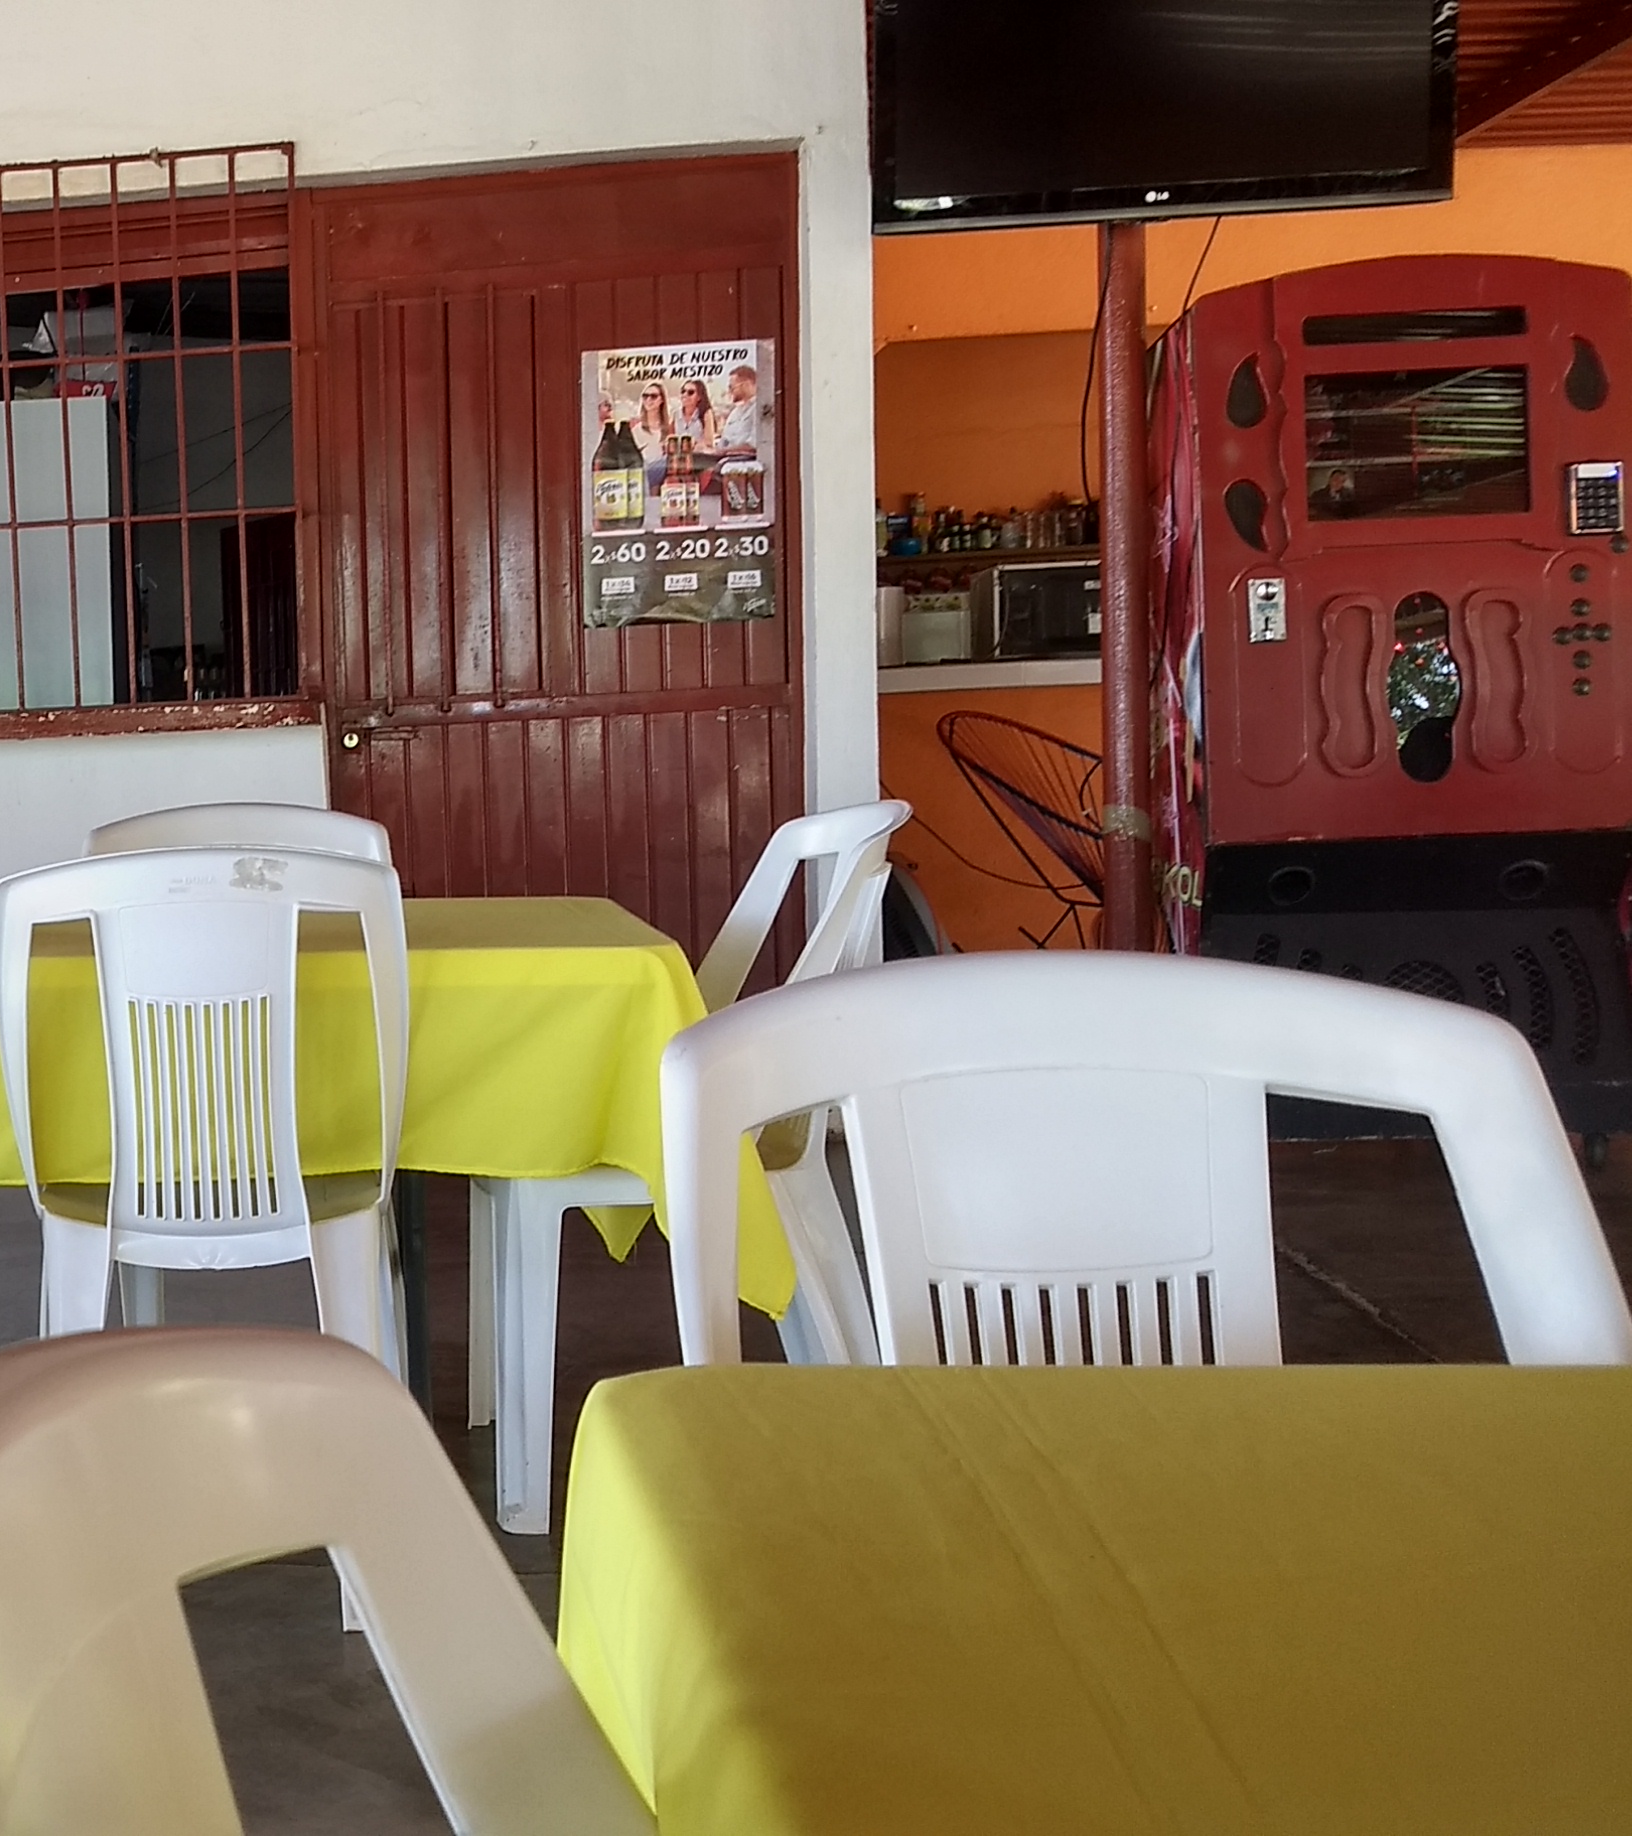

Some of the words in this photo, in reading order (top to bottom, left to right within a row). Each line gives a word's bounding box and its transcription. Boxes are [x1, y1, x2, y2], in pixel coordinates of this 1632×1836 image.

[606, 354, 664, 370] DISFRUTA
[669, 352, 687, 366] DE
[690, 348, 749, 364] NUESTRO
[627, 369, 667, 382] SABOR
[669, 364, 723, 379] MESTIZO
